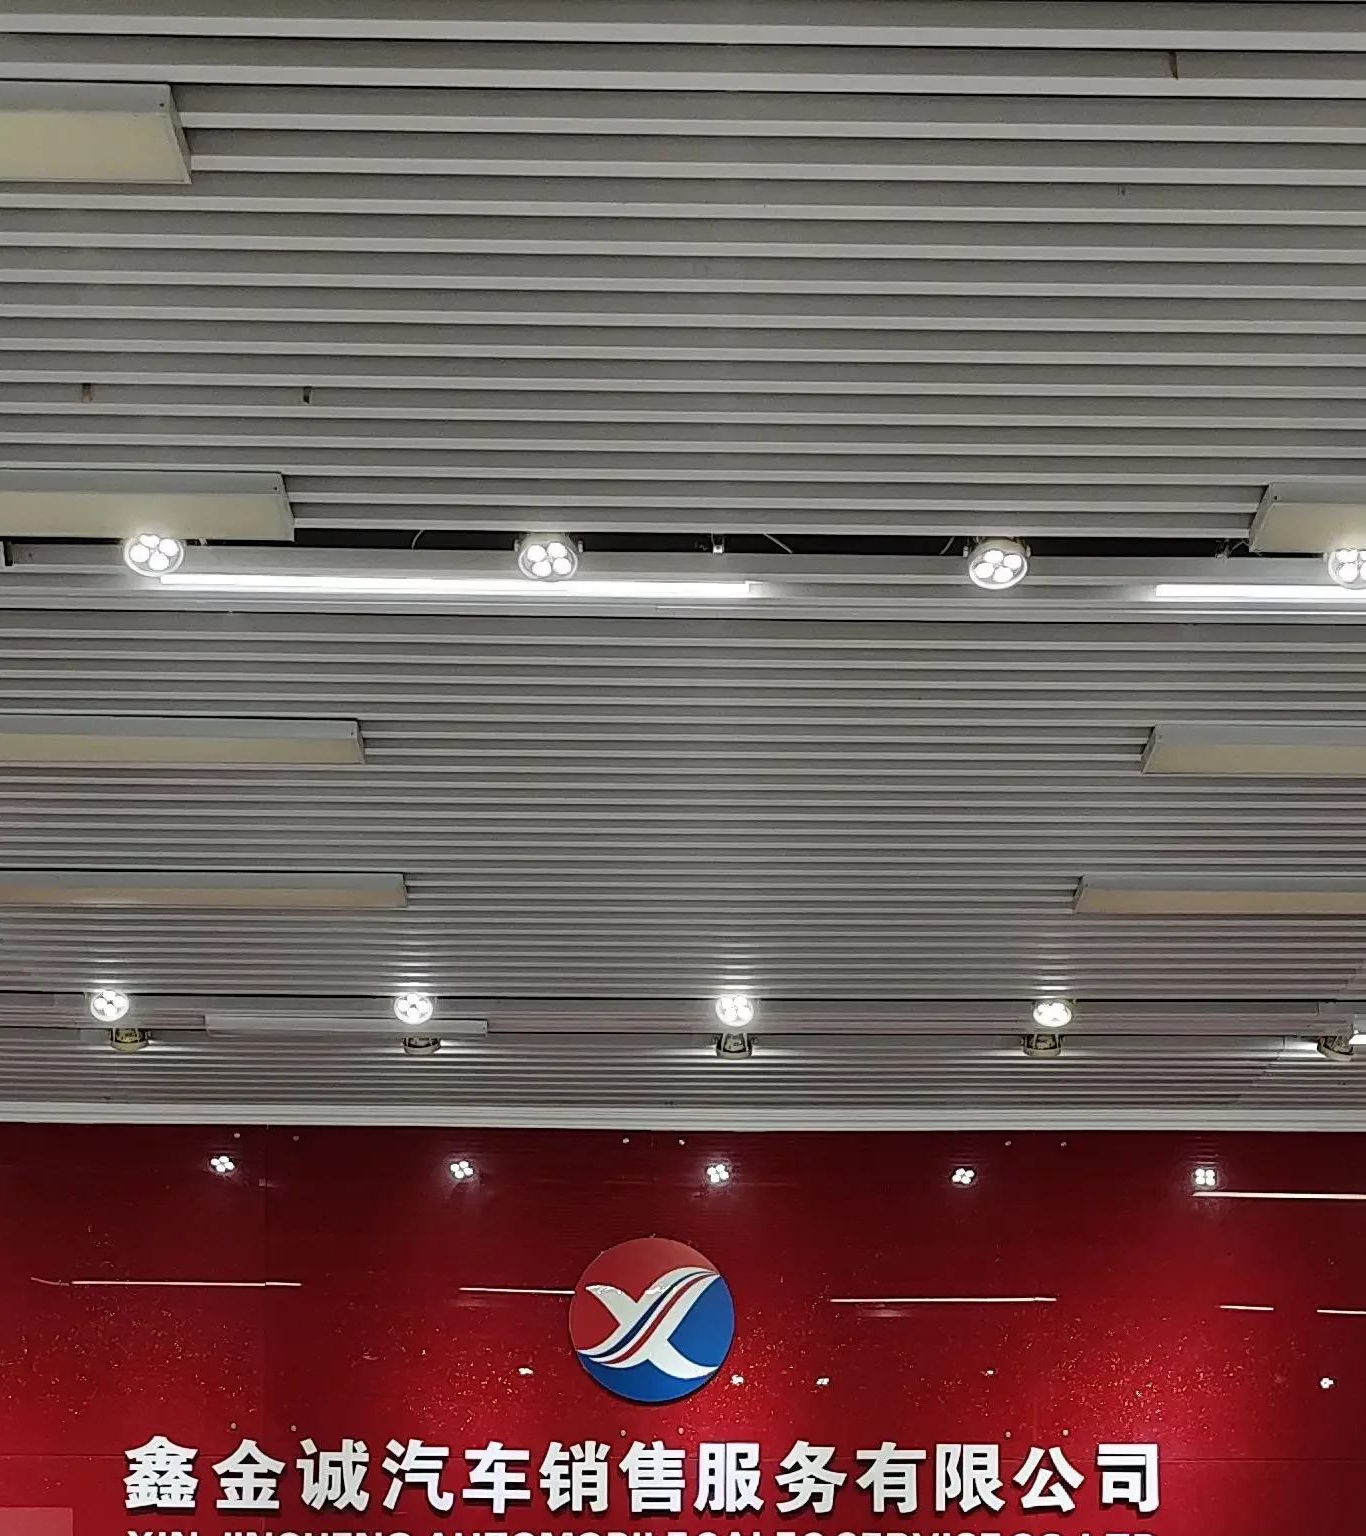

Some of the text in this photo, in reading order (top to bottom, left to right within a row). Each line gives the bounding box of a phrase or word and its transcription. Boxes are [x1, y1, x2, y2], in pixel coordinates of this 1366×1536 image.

[123, 1433, 1162, 1513] 鑫金诚汽车销售服务有限公司
